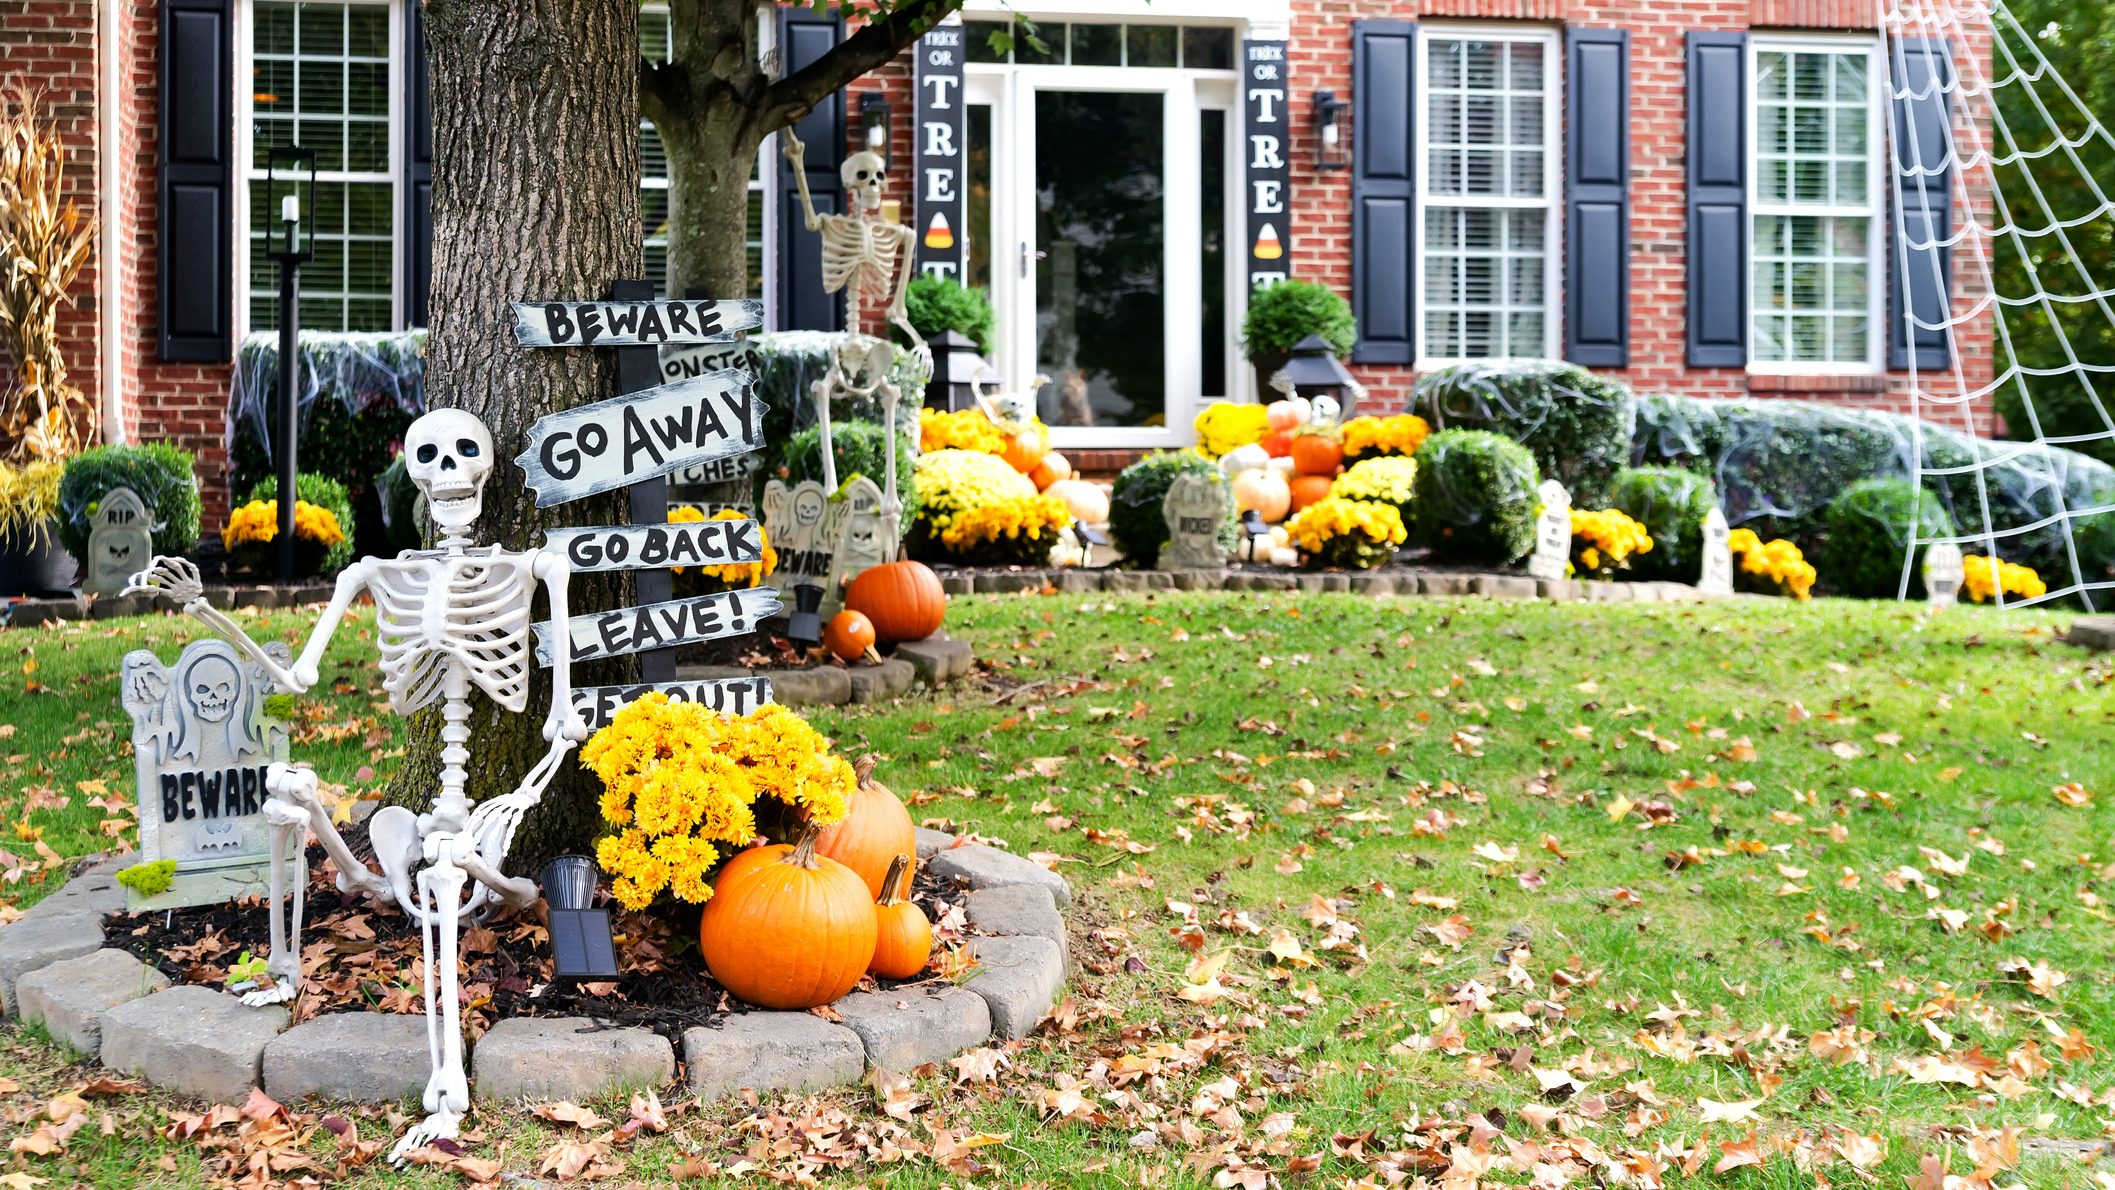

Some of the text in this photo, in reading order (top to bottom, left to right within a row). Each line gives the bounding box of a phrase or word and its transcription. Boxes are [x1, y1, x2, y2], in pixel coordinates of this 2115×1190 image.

[929, 50, 955, 66] OR
[1253, 64, 1280, 80] OR
[922, 74, 959, 284] TRET
[544, 299, 723, 344] BEWARE
[660, 349, 763, 384] ONSTER
[540, 385, 754, 481] GO AWAY
[108, 510, 134, 524] RIP
[568, 521, 762, 567] GO BACK
[570, 592, 745, 660] LEAVE!
